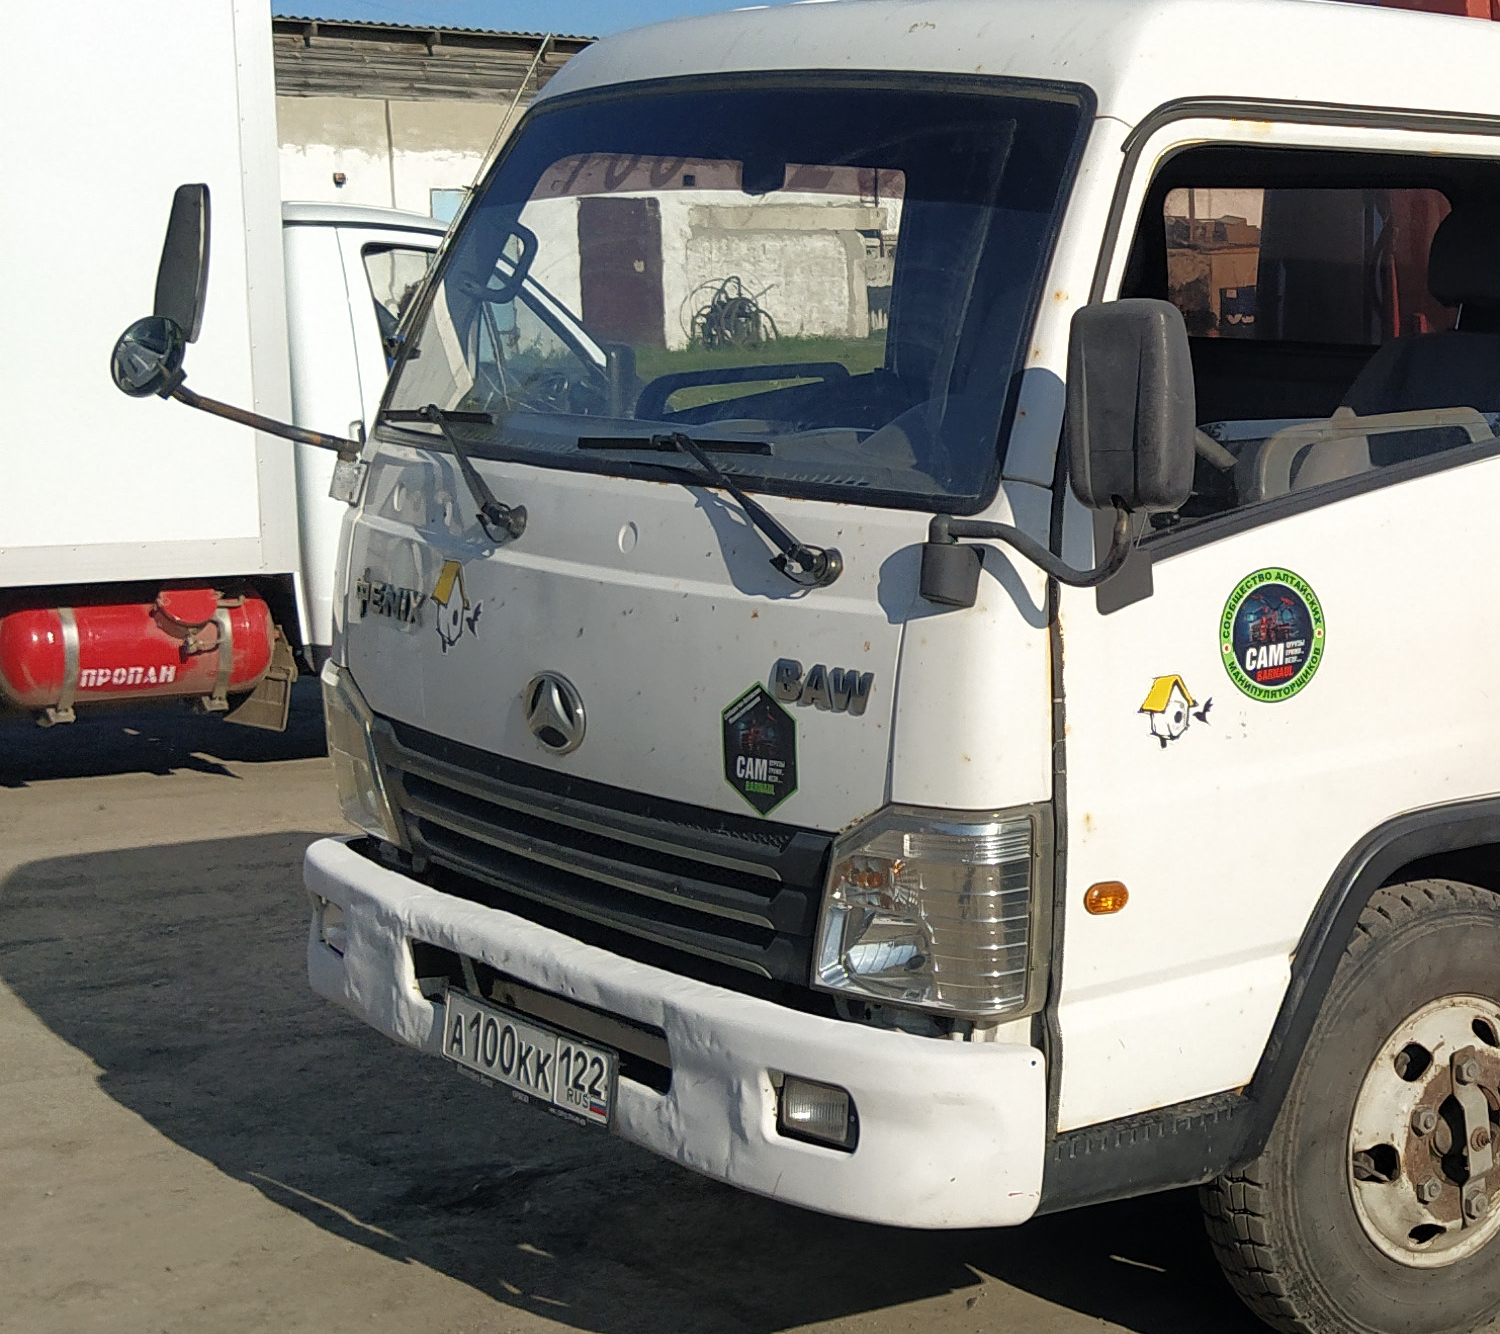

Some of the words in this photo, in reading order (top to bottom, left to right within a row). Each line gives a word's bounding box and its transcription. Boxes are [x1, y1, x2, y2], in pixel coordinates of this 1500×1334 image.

[1223, 571, 1272, 639] СООБЩЕСТВО
[1275, 571, 1322, 624] АЛТАЙСКИХ
[80, 665, 177, 687] ПРОПАН
[768, 658, 875, 717] BAW
[1228, 647, 1321, 699] МАНИПУЛЯТОРЩИКОВ
[560, 1044, 607, 1100] 122
[566, 1088, 589, 1108] RUS
